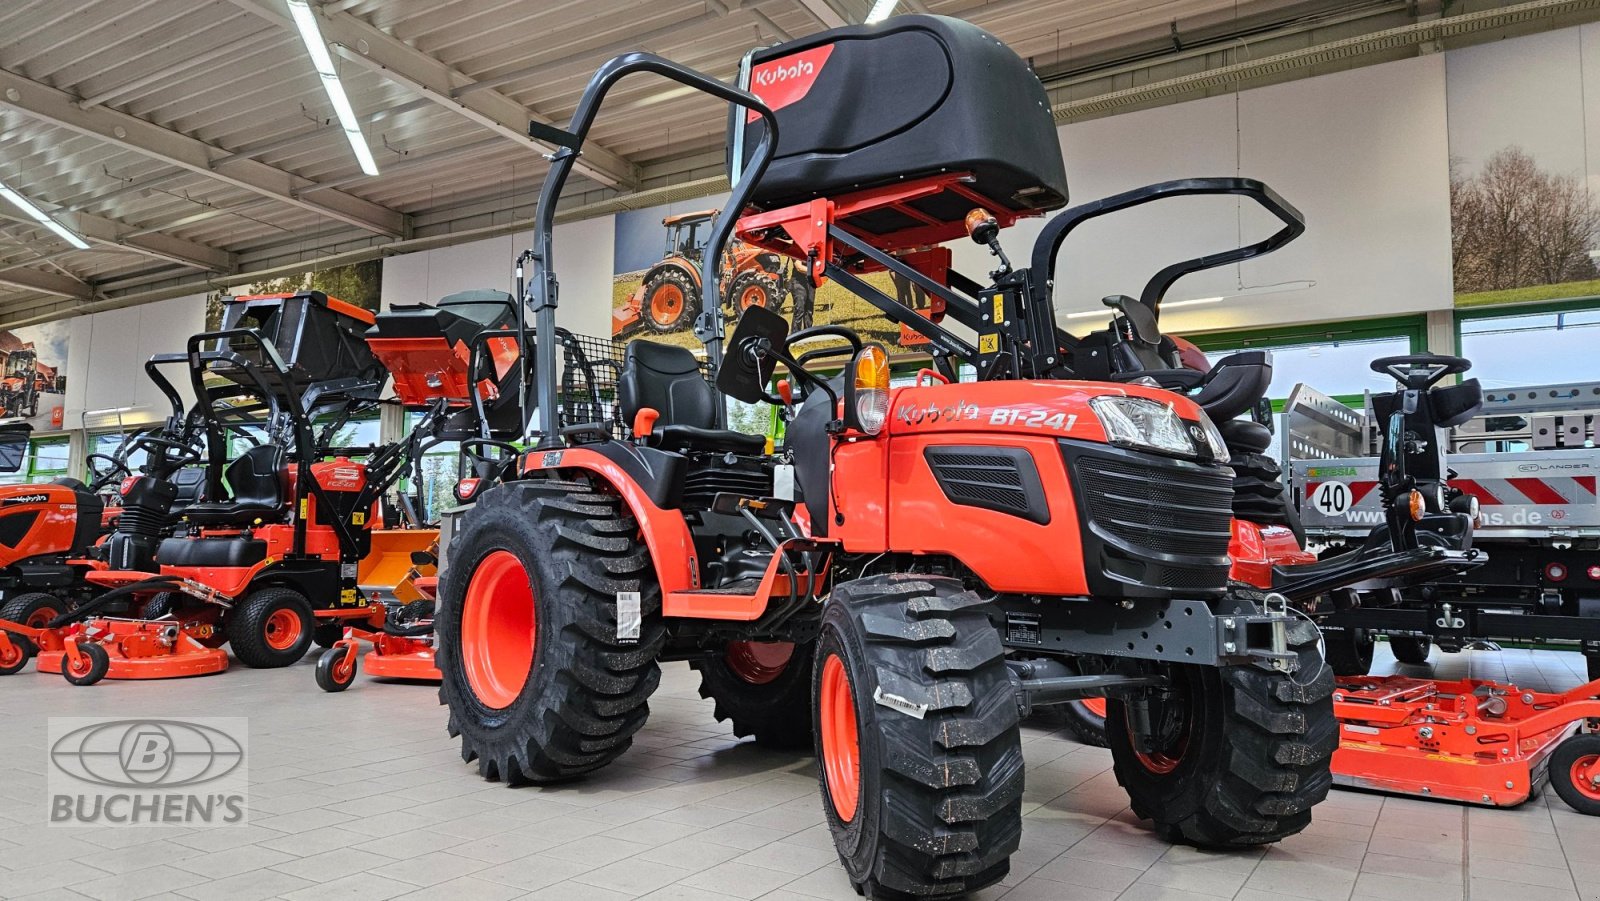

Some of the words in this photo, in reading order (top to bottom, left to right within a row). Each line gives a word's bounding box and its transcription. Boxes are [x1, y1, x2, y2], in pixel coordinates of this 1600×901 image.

[755, 59, 814, 87] Kubota
[897, 400, 980, 426] Kubota
[989, 408, 1078, 432] B1-241
[17, 494, 47, 503] Kubota
[1320, 484, 1345, 512] 40
